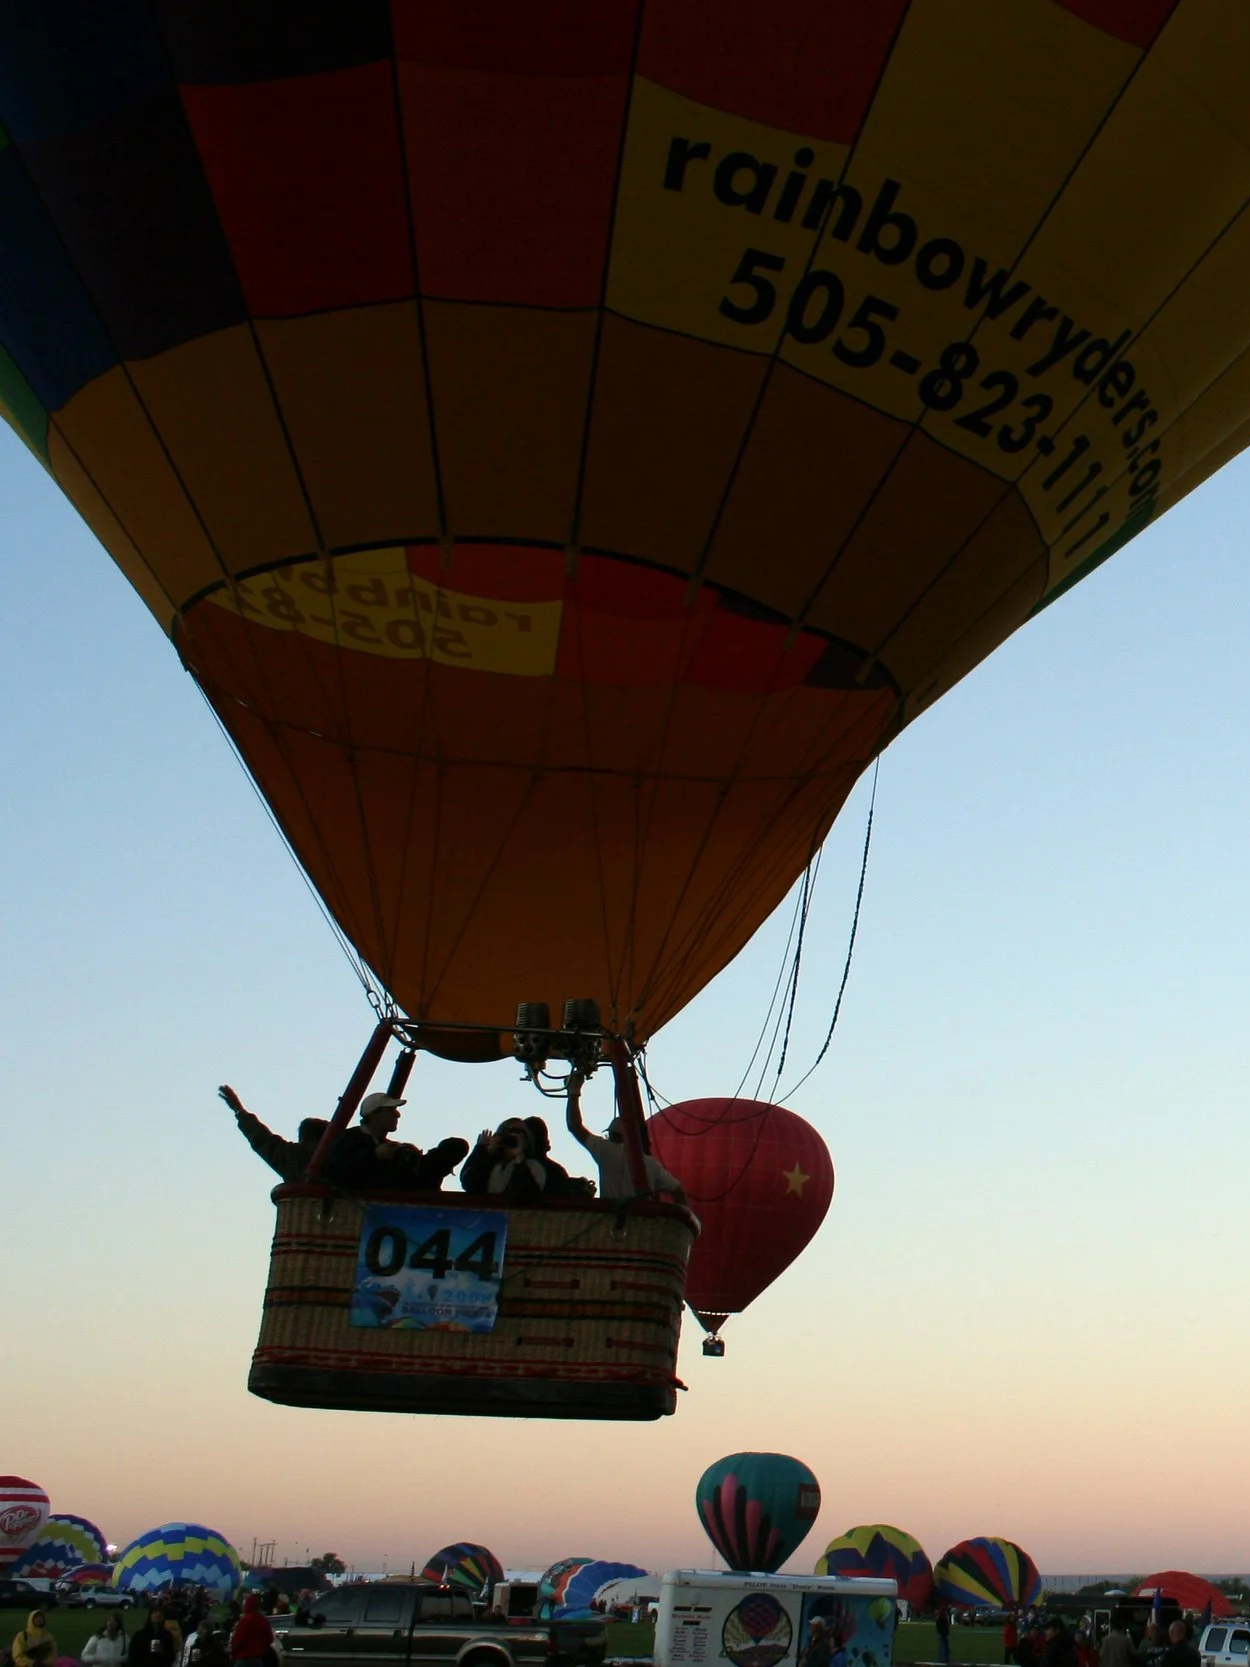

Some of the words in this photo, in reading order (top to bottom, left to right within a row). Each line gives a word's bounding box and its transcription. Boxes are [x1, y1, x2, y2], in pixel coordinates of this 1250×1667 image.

[663, 135, 1161, 520] rainbowryders.com
[719, 247, 1110, 560] 505-823-1111
[365, 1227, 499, 1282] 044
[4, 1513, 37, 1531] Pepper
[16, 1510, 29, 1520] Dr
